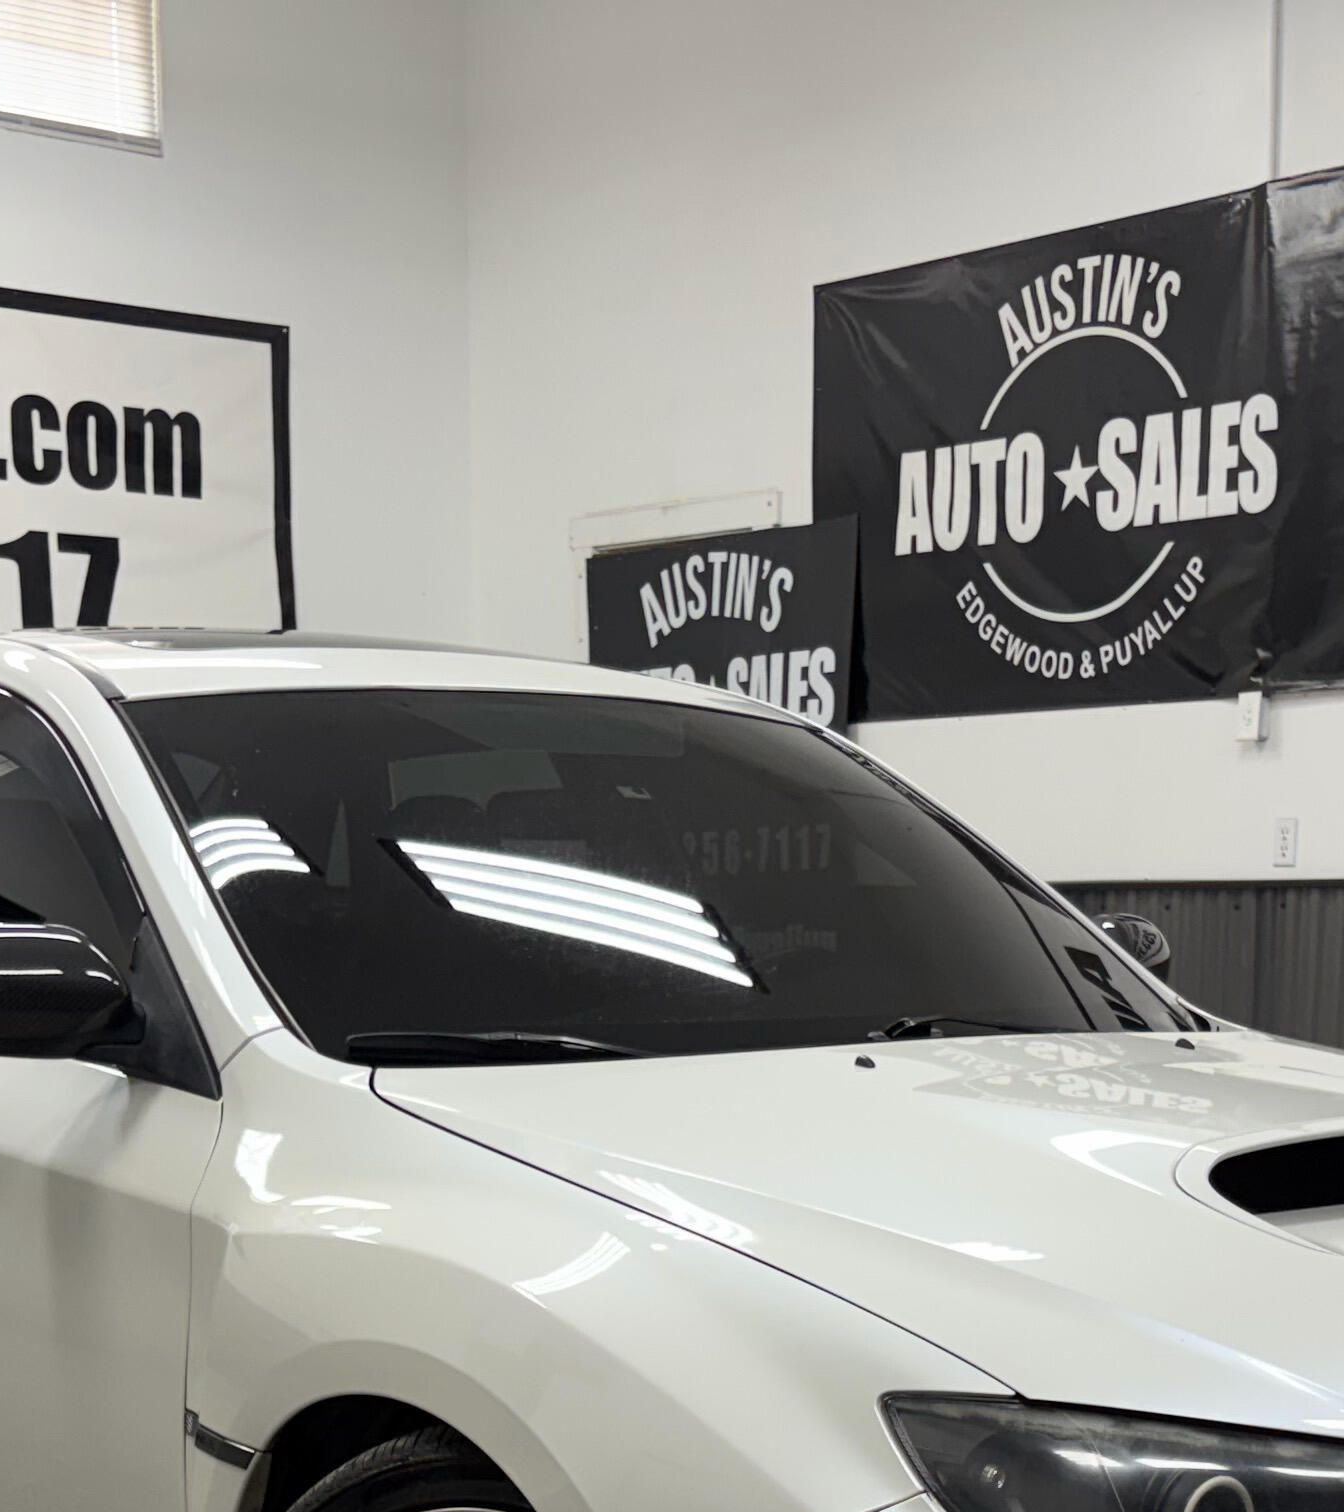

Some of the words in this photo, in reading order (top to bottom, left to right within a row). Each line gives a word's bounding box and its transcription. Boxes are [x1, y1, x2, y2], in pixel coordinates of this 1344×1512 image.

[999, 253, 1181, 368] AUSTIN'S
[895, 432, 1045, 557] AUTO
[1096, 394, 1279, 533] SALES
[639, 551, 794, 648] AUSTIN'S
[956, 581, 1074, 680] EDGEWOOD
[1079, 650, 1095, 679] &
[1099, 555, 1206, 674] PUYALLUP
